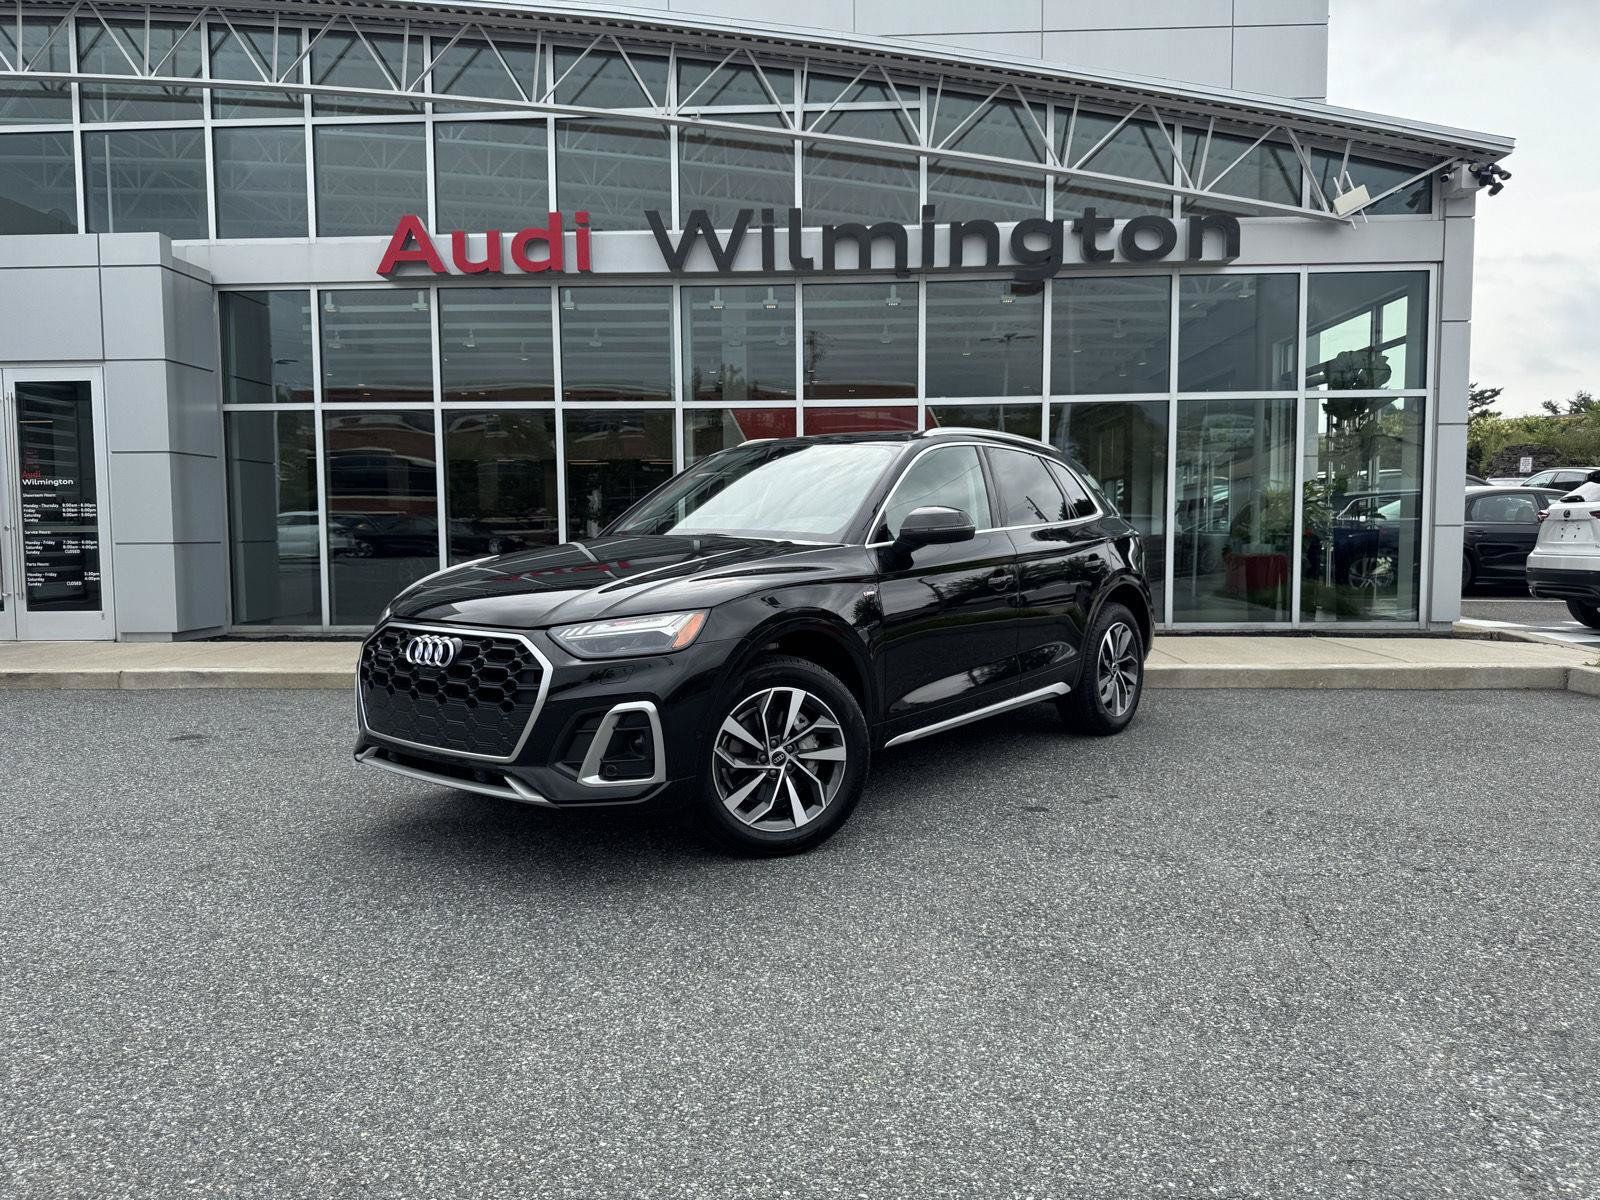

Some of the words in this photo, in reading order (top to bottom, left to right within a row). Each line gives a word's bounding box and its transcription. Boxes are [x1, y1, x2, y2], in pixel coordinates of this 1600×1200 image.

[376, 211, 592, 276] Audi
[645, 204, 1241, 281] Wilmington
[22, 470, 41, 479] Audi
[22, 479, 74, 487] Wilmington
